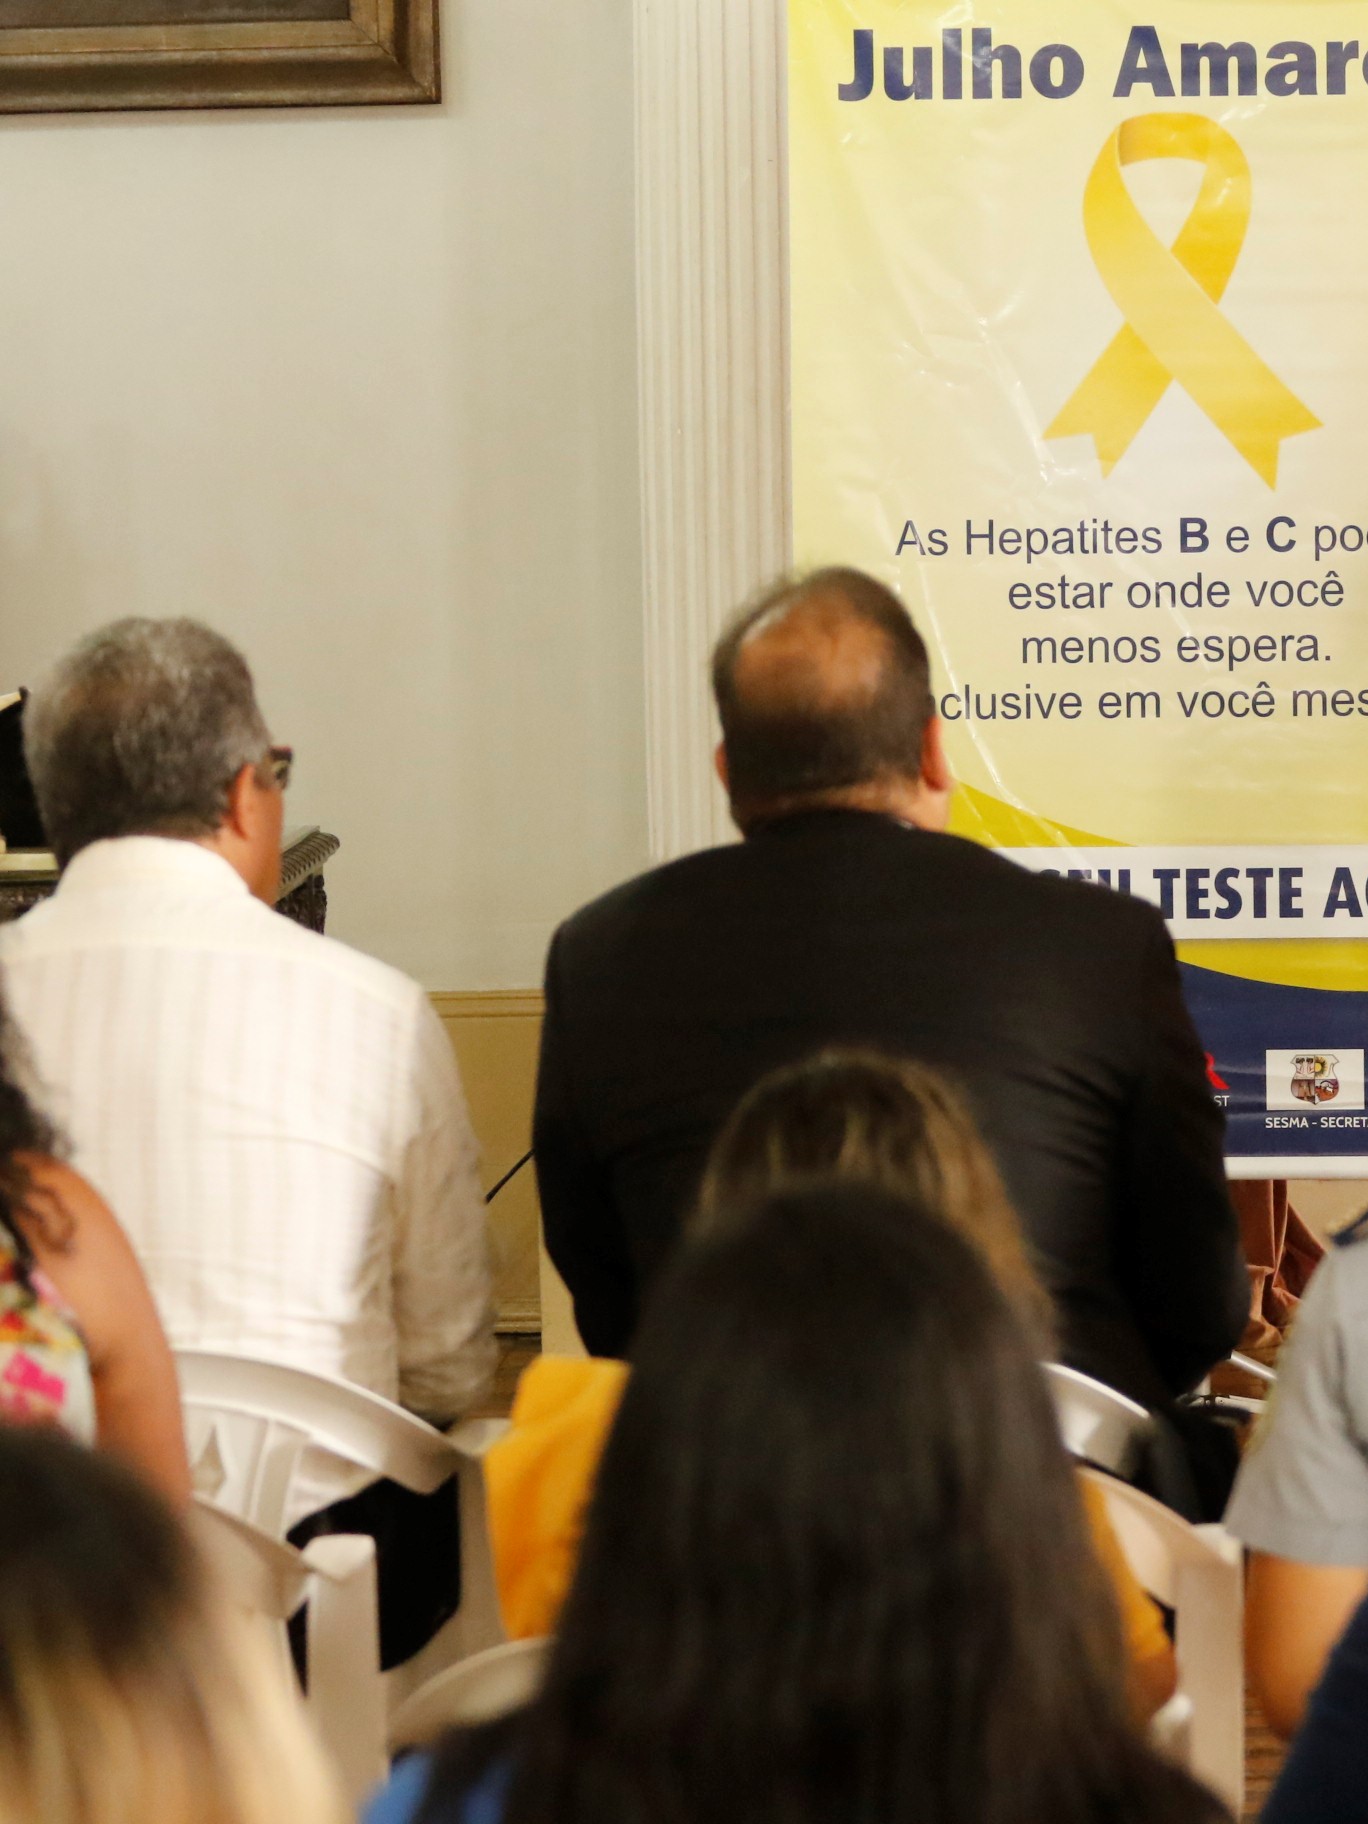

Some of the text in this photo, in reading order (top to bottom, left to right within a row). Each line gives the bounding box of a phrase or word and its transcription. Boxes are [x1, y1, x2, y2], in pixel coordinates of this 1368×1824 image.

[838, 28, 1084, 101] Julho
[895, 519, 949, 556] As
[965, 517, 1163, 564] Hepatites
[1179, 517, 1209, 553] B
[1226, 526, 1250, 553] e
[1265, 516, 1297, 554] C
[1008, 570, 1345, 610] estar onde você
[1022, 631, 1333, 671] menos espera.
[1101, 689, 1163, 720] em
[1177, 682, 1276, 719] você
[1153, 867, 1305, 919] TESTE
[1265, 1116, 1309, 1128] SESMA
